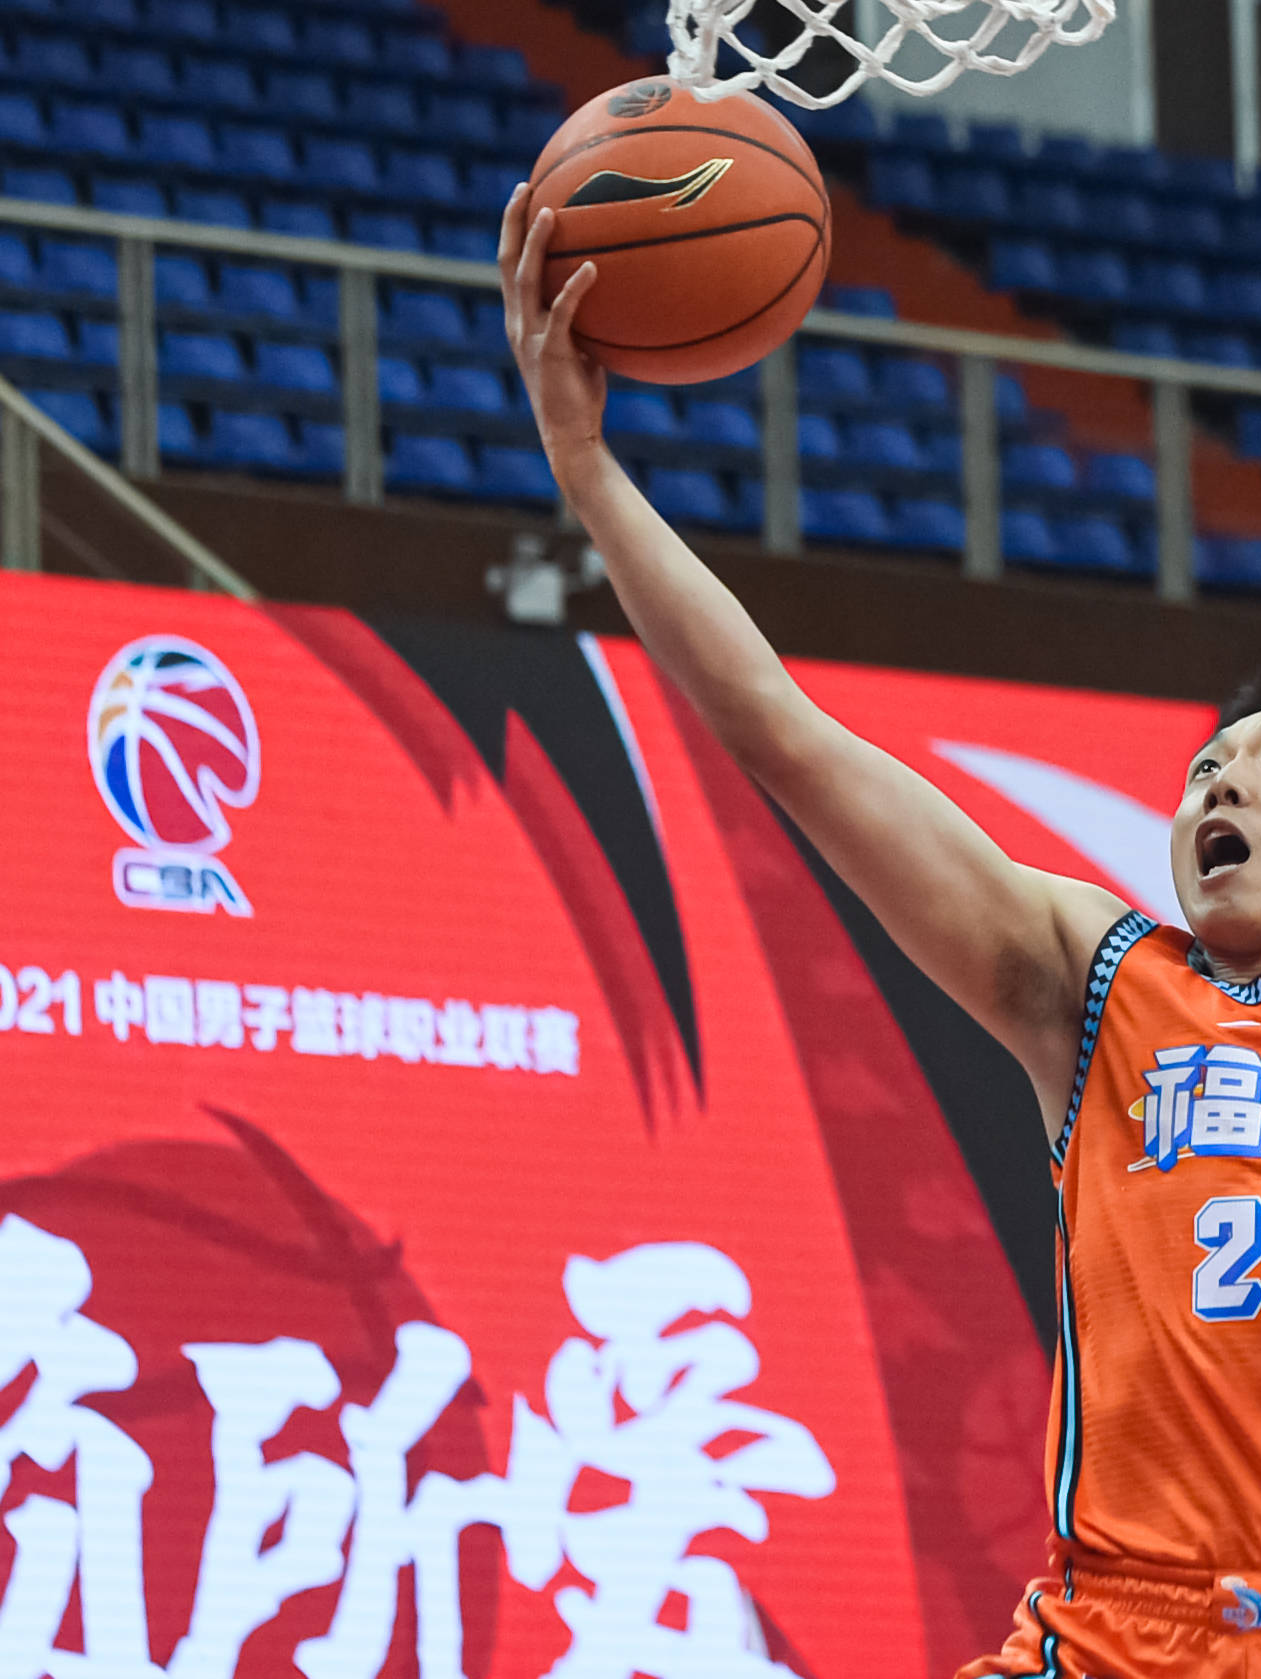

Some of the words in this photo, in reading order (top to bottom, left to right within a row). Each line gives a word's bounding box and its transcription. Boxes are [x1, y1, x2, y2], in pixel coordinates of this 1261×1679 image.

[118, 855, 246, 910] CBA
[94, 969, 580, 1077] 中国男子篮球职业联赛
